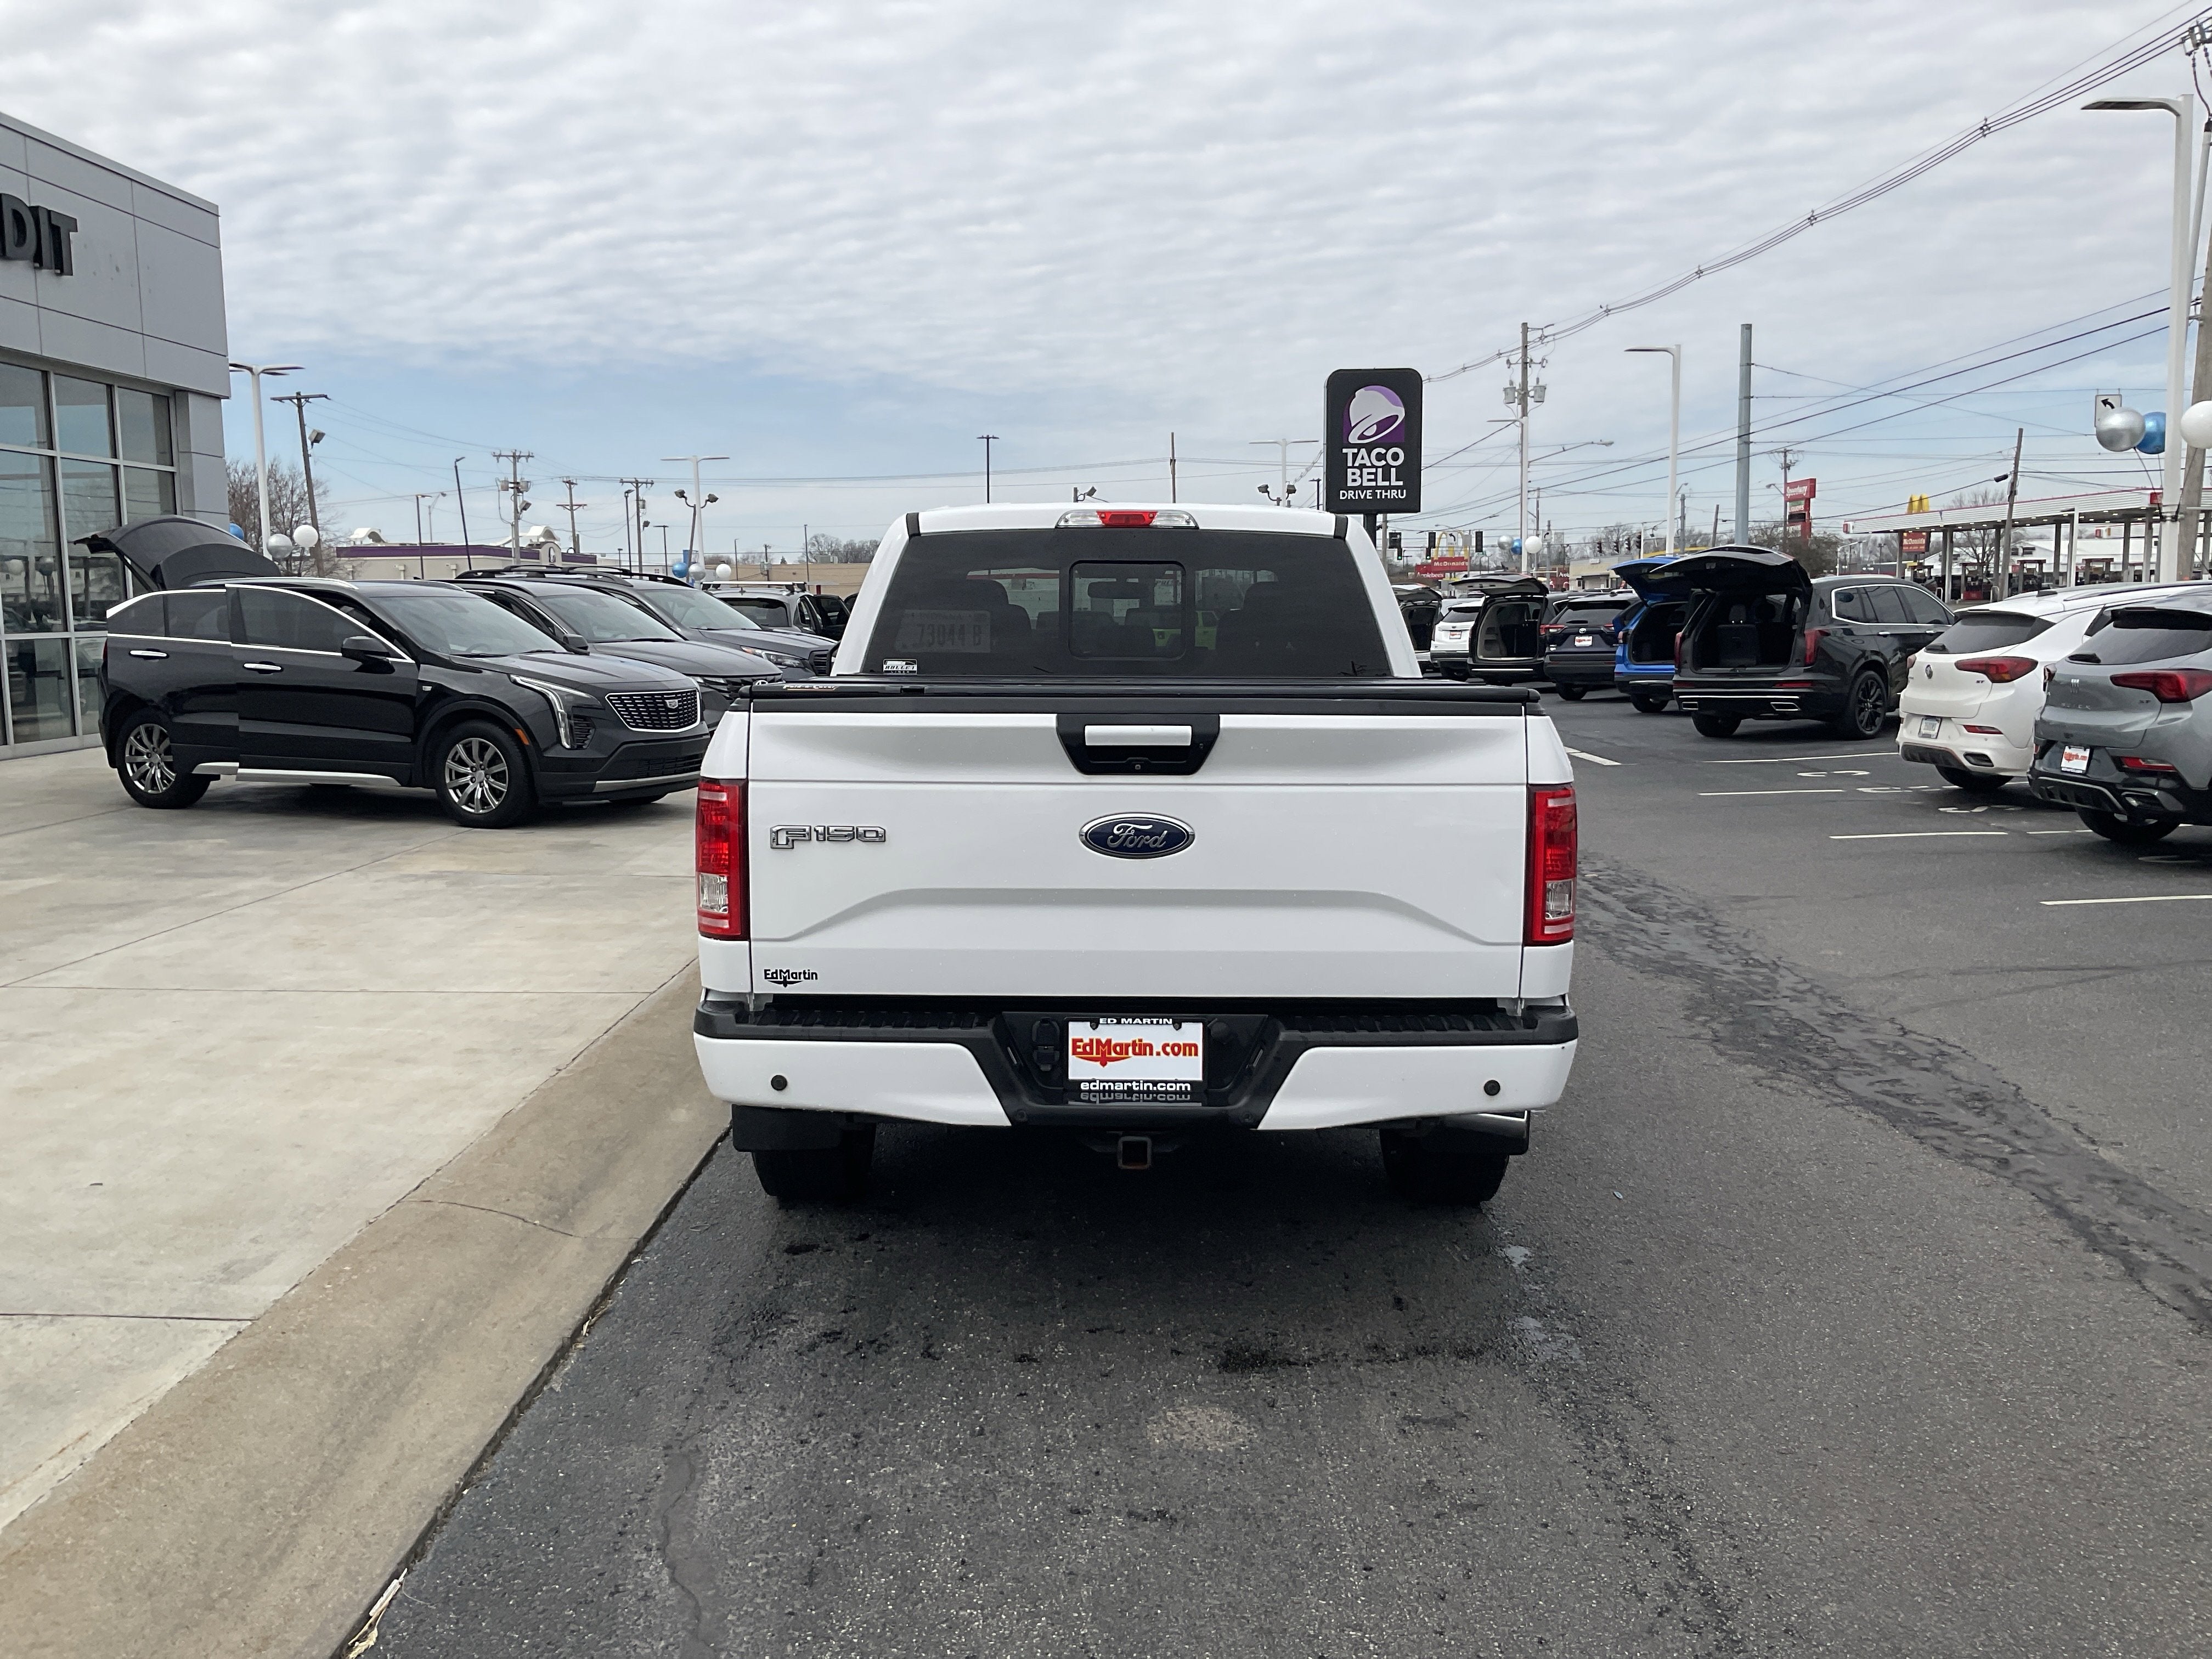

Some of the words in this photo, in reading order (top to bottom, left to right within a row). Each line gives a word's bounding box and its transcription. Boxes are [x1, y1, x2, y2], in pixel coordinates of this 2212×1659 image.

[1342, 448, 1404, 466] TACO
[1347, 468, 1403, 487] BELL
[1340, 490, 1372, 500] DRIVE
[1375, 489, 1406, 499] THRU
[770, 825, 886, 849] F150
[1107, 823, 1168, 848] Ford
[1080, 1080, 1191, 1091] edmartin.com
